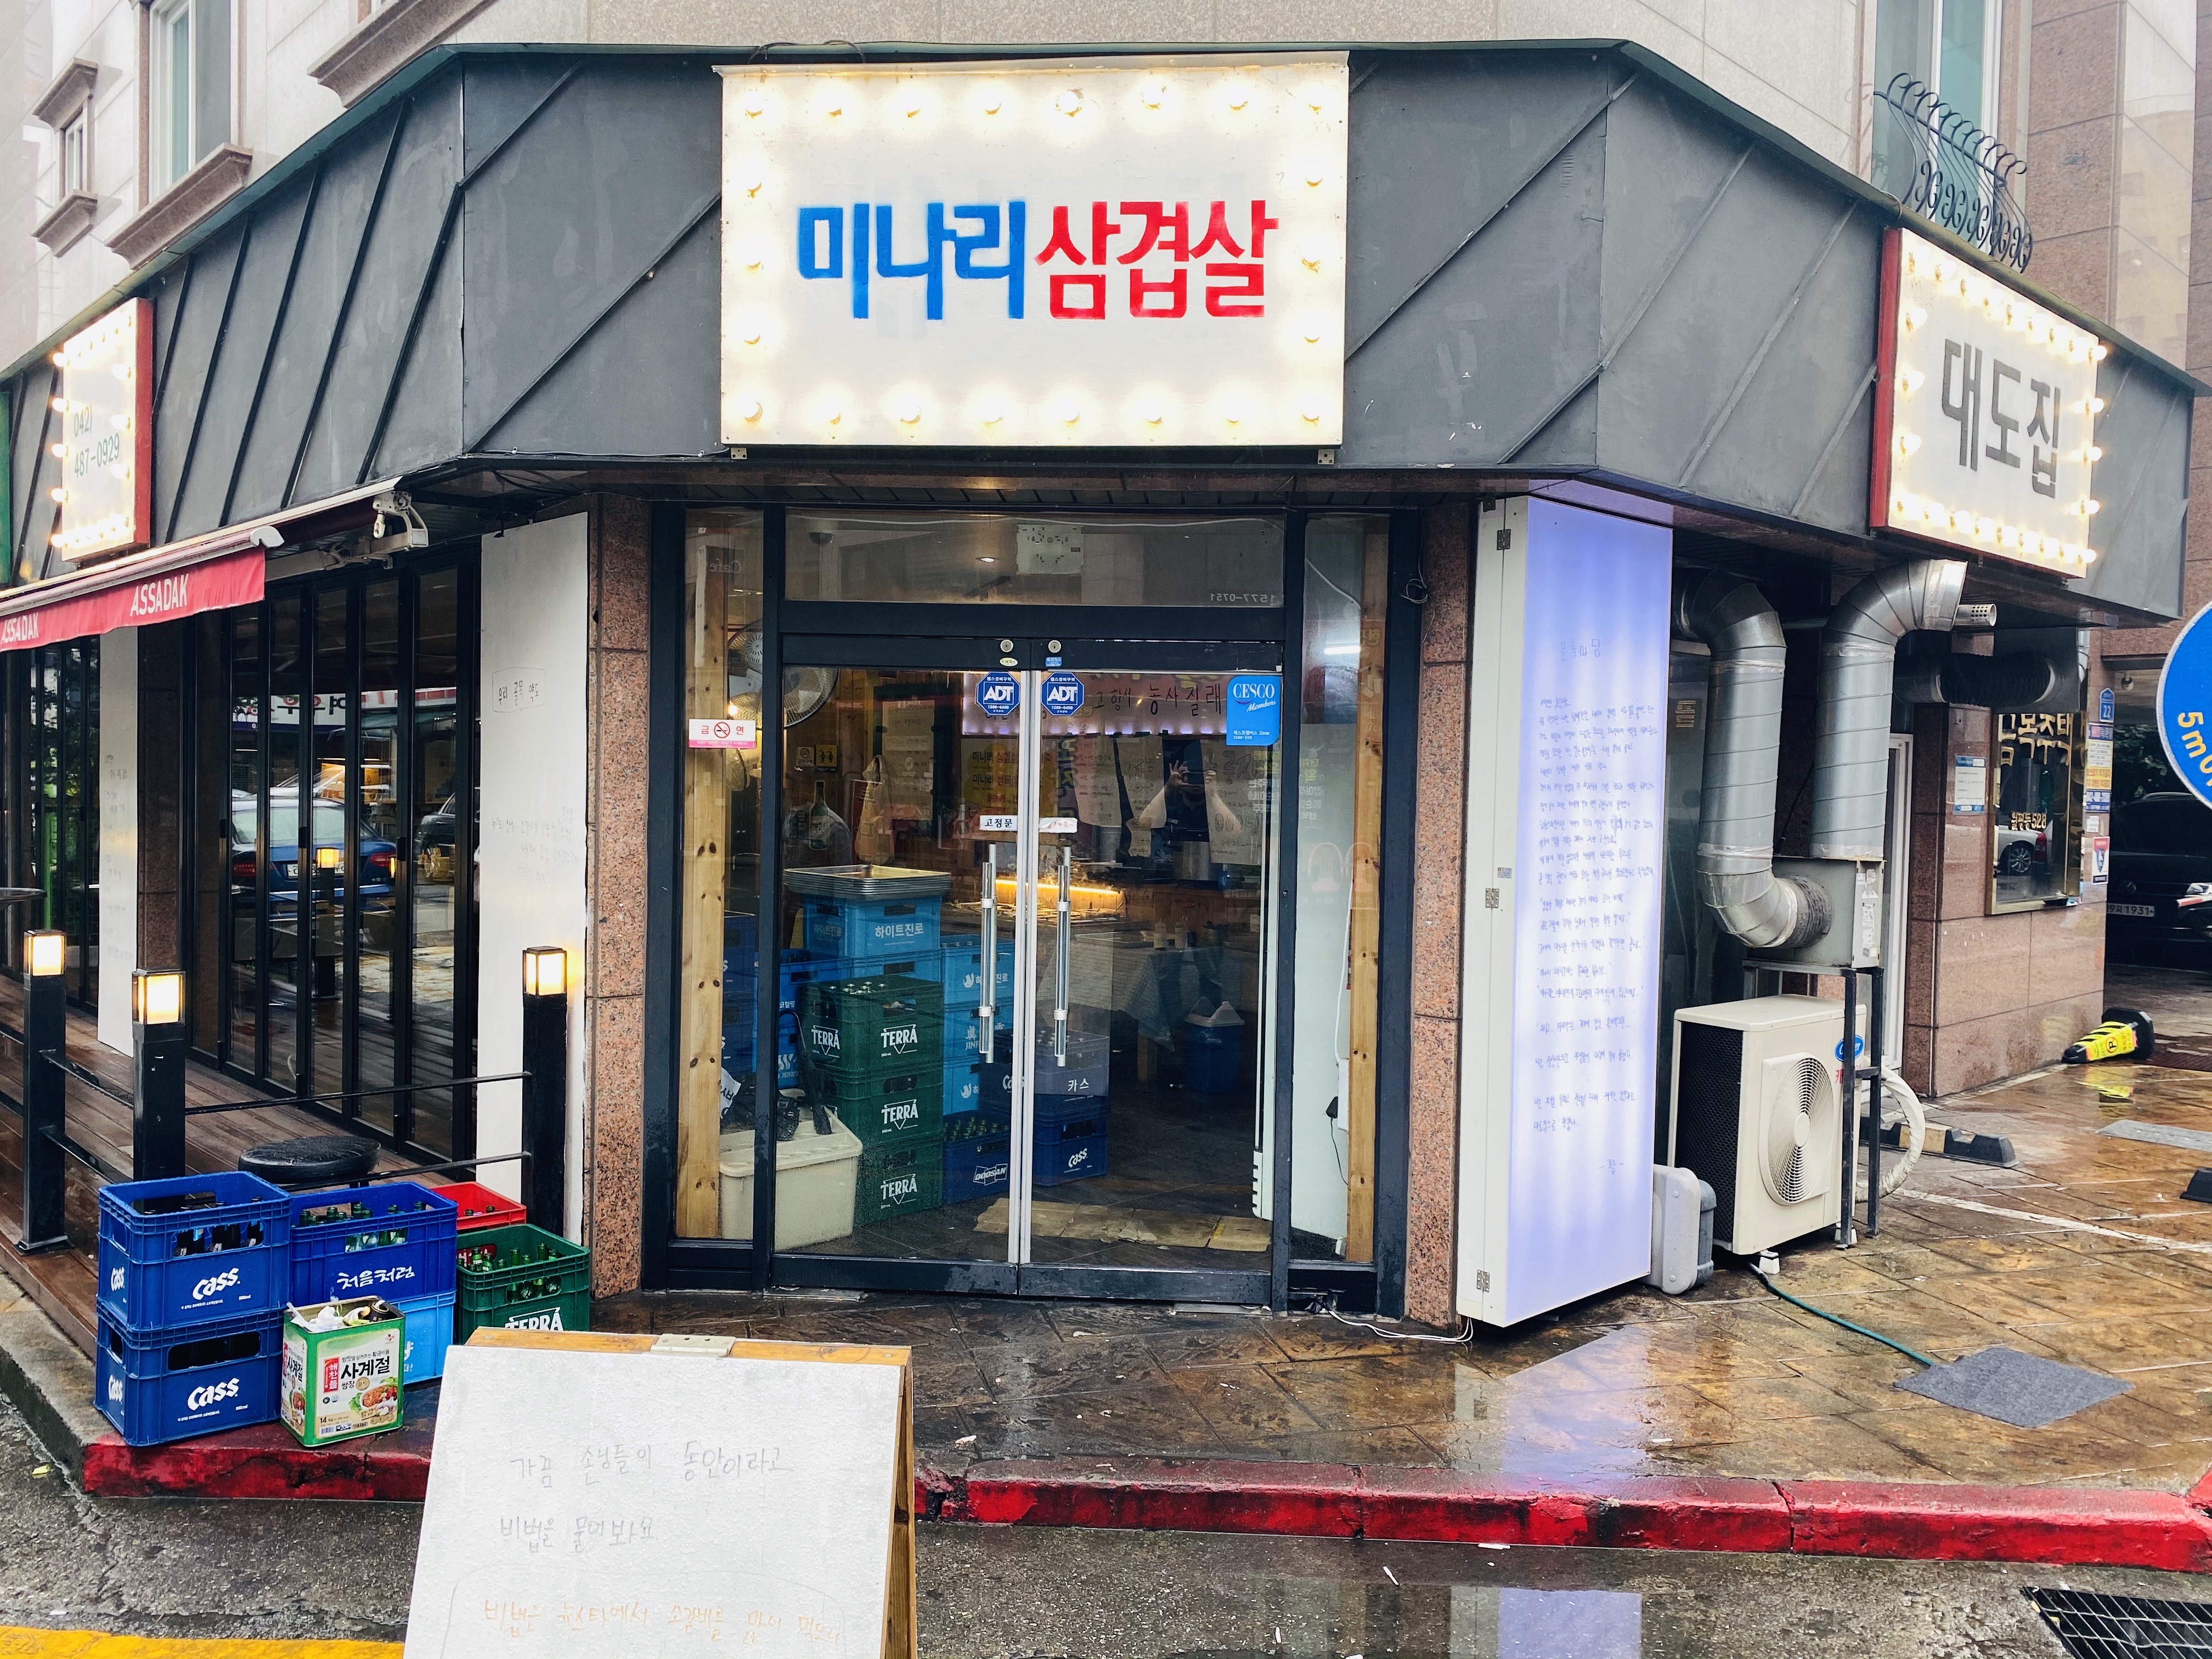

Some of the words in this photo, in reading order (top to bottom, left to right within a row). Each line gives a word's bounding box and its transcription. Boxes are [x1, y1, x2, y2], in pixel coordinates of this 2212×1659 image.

[1942, 338, 2061, 499] 대도집
[74, 432, 120, 478] 487-0929
[129, 573, 190, 617] ASSADAK
[1, 612, 39, 644] ASSADAK
[499, 686, 508, 706] 우리
[514, 680, 523, 706] 골목
[529, 683, 539, 702] 약도
[984, 686, 1014, 701] ADT
[1047, 686, 1078, 701] ADT
[1233, 684, 1275, 699] CESCO
[1246, 699, 1277, 713] Members
[2103, 705, 2111, 718] 22
[985, 818, 1013, 828] 고정문
[874, 922, 924, 939] 하이트진로
[811, 1029, 840, 1050] TERRA
[881, 1028, 918, 1048] TERRA
[1067, 1077, 1090, 1092] 카스
[881, 1103, 919, 1125] TERRA
[975, 1166, 1007, 1182] DOOSAN
[880, 1177, 918, 1201] TERRA
[192, 1267, 241, 1300] Cass
[336, 1266, 416, 1290] 처음처럼
[328, 1363, 339, 1390] 해찬들
[341, 1356, 391, 1380] 사계절
[187, 1378, 240, 1411] Cass
[341, 1381, 356, 1390] 쌈장
[510, 1454, 553, 1488] 가끔
[581, 1444, 652, 1487] 손님들이
[684, 1440, 794, 1482] 동안이라고
[500, 1515, 554, 1554] 비법을
[484, 1600, 542, 1638] 비법은
[556, 1602, 648, 1631] 뉴스타에서
